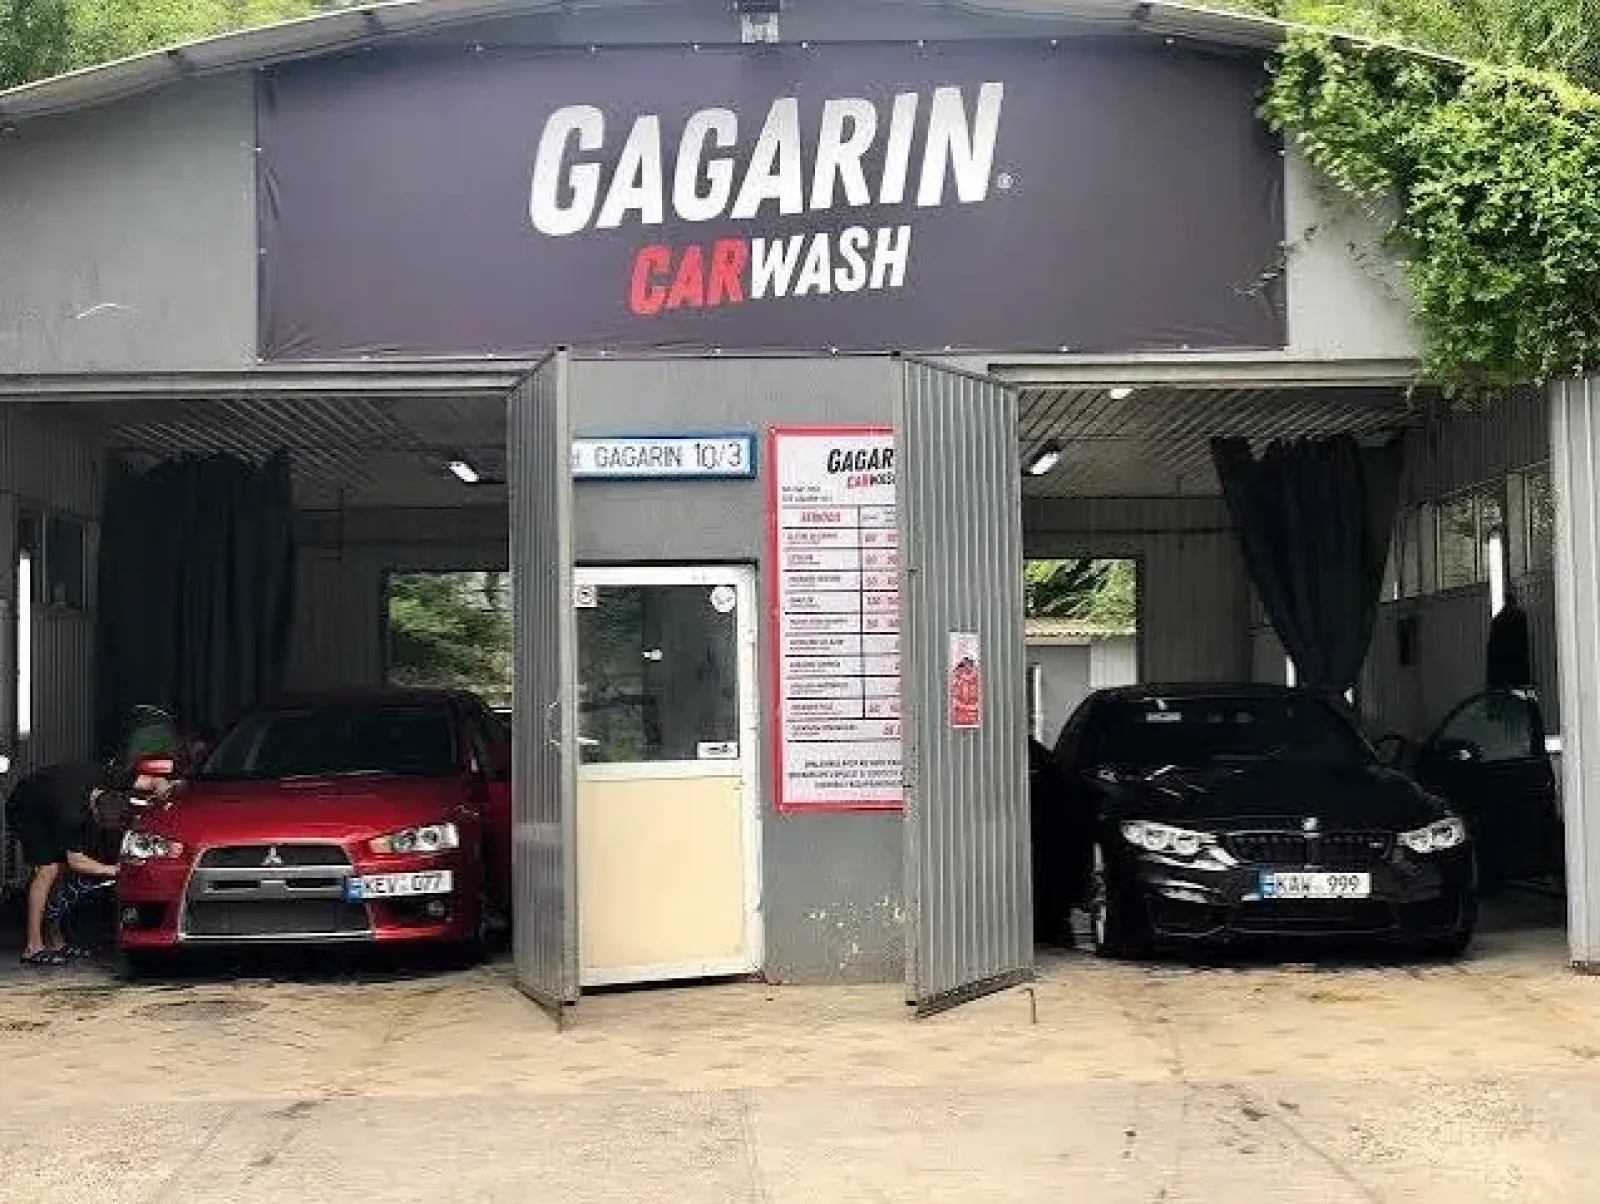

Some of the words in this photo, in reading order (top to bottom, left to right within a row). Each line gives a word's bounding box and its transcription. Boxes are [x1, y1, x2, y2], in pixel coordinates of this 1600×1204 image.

[530, 82, 1003, 236] GAGARIN
[594, 445, 682, 468] GAGARIN
[694, 441, 742, 469] 10/3
[364, 876, 397, 894] KEV
[410, 872, 443, 891] 077
[1326, 874, 1360, 892] 999
